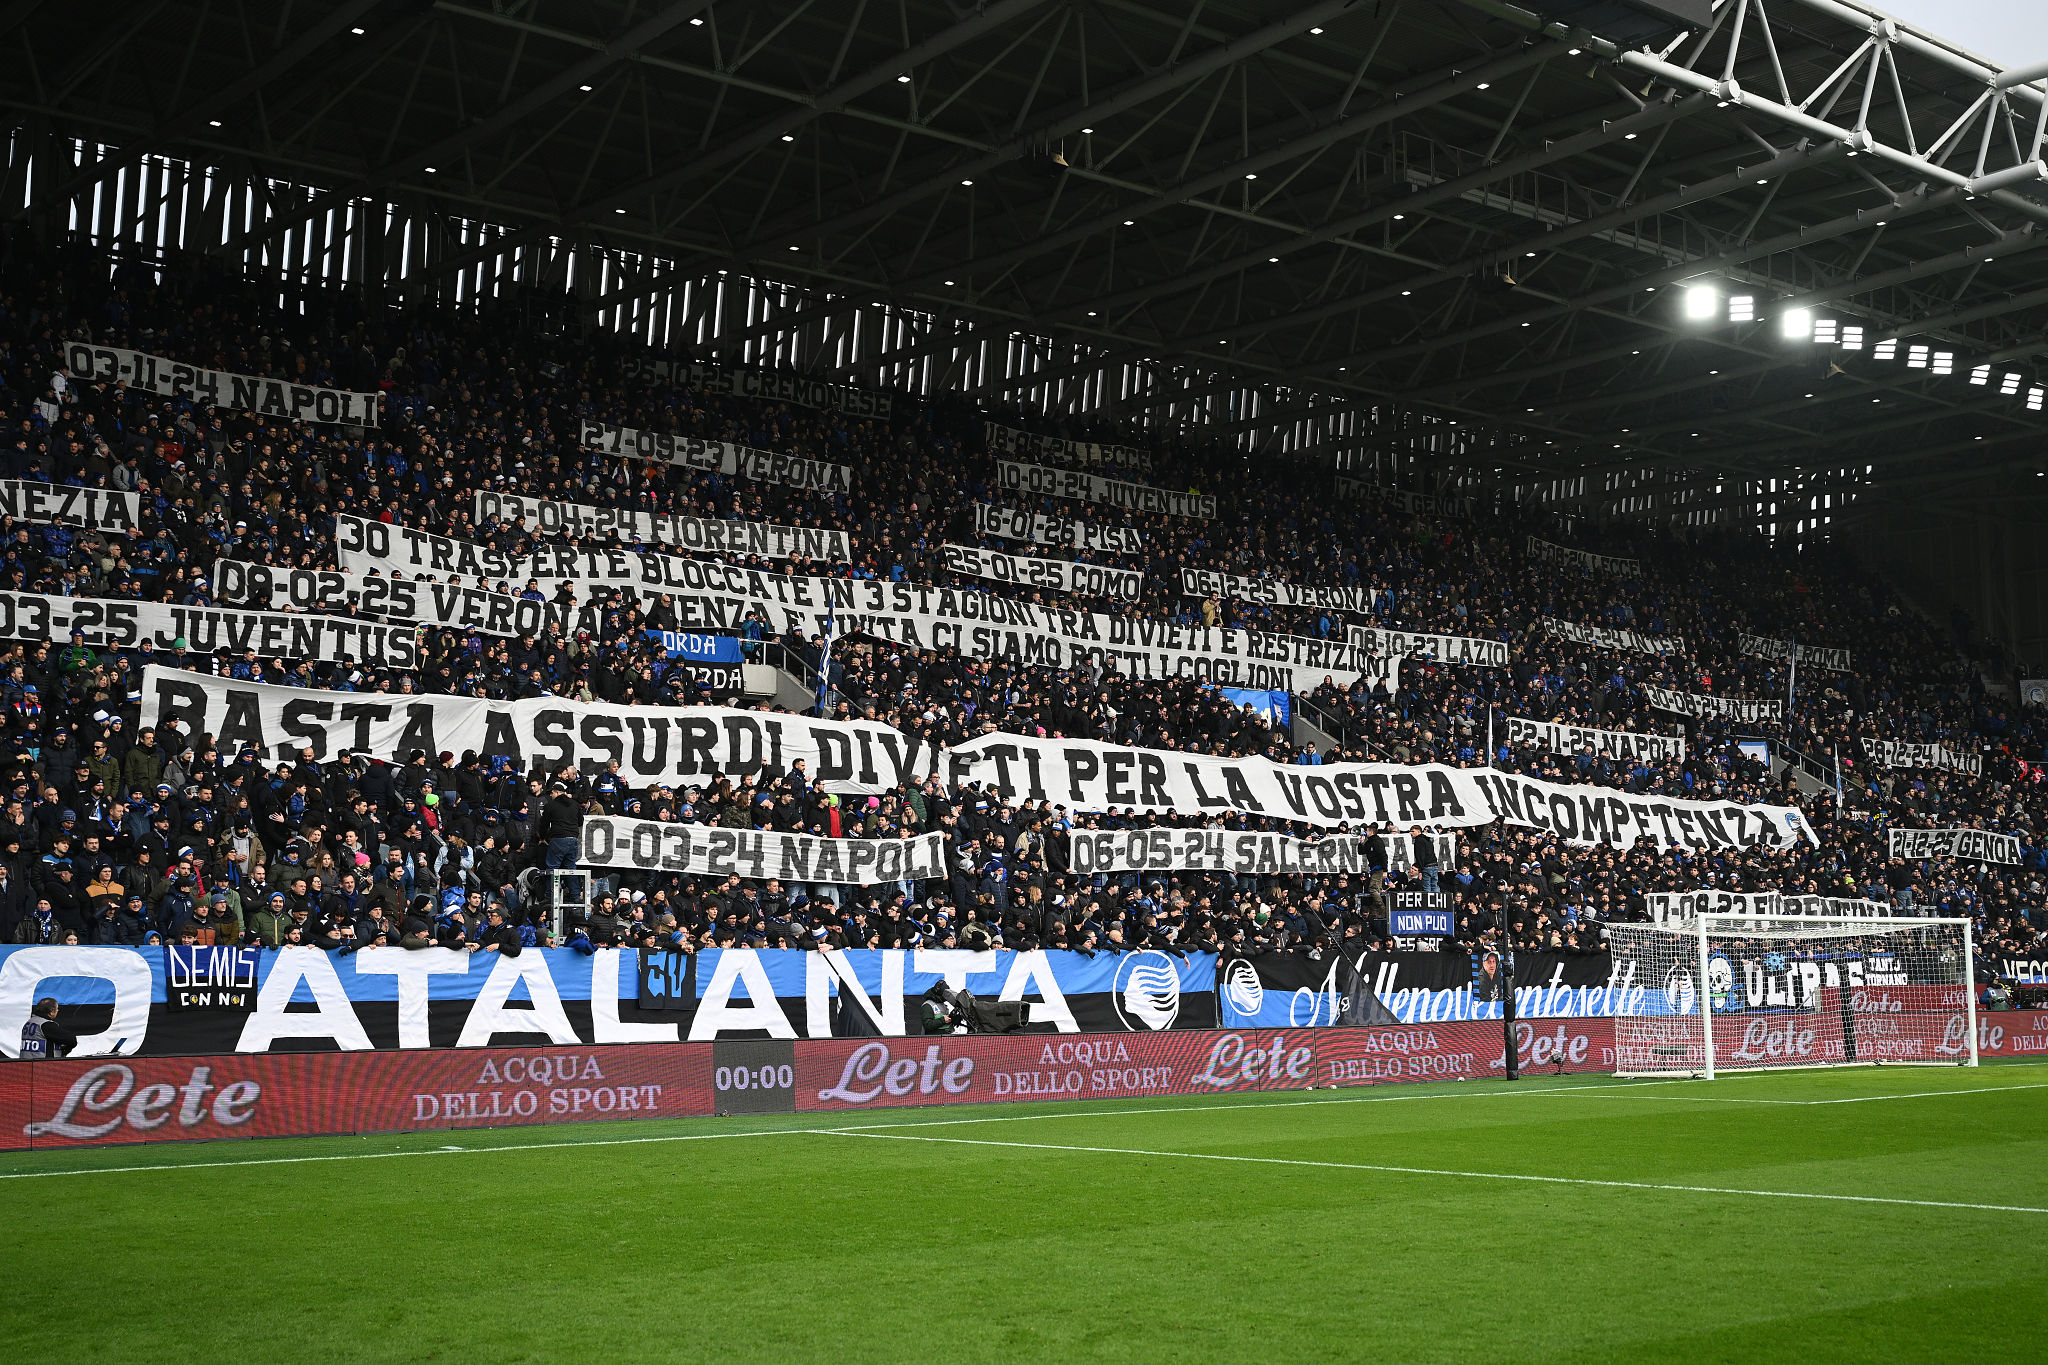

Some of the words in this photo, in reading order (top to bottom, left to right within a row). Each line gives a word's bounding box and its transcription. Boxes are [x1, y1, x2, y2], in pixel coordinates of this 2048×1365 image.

[68, 344, 219, 401] 03-11-24
[230, 376, 376, 428] NAPOLI
[743, 371, 891, 417] CREMONESE
[584, 423, 723, 469] 27-09-23
[736, 446, 848, 490] VERONA
[1000, 463, 1092, 500] 10-03-24
[1100, 481, 1214, 518] JUVENTUS
[481, 491, 638, 540] 03-04-24
[650, 514, 847, 561] FIORENTINA
[978, 504, 1076, 545] 16-01-26
[1084, 522, 1141, 552] PISA
[340, 515, 389, 559] 30
[403, 528, 631, 579] TRASFERTE
[640, 553, 813, 607] BLOCCATE
[820, 578, 855, 609] IN
[864, 581, 885, 611] 3
[892, 583, 1037, 627] STAGIONI
[1038, 605, 1100, 641] TRA
[1109, 614, 1211, 652] DIVIETI
[1220, 627, 1238, 655] E
[1246, 631, 1391, 678] RESTRIZIONI
[947, 548, 1063, 590] 25-01-25
[1071, 565, 1140, 601] COMO
[1183, 568, 1277, 604] 06-12-25
[1283, 583, 1375, 614] VERONA
[431, 583, 600, 644] VERONA
[155, 608, 415, 668] JUVENTUS
[663, 631, 716, 655] ORDA
[932, 622, 962, 655] CI
[972, 627, 1062, 668] SIAMO
[1178, 656, 1293, 690] COGLIONI
[1446, 639, 1506, 667] LAZIO
[687, 665, 742, 690] RDA
[156, 677, 438, 767] BASTA
[479, 709, 786, 778] ASSURDI
[1064, 748, 1174, 806] PER
[1184, 762, 1264, 812] LA
[1273, 769, 1464, 822] VOSTRA
[1473, 774, 1783, 847] INCOMPETENZA
[1601, 733, 1681, 763] NAPOLI
[780, 835, 944, 883] NAPOLI
[1073, 830, 1225, 874] 06-05-24
[1235, 835, 1455, 873] SALERNAA
[1958, 831, 2023, 864] GENOA
[1396, 892, 1422, 908] PER
[1427, 892, 1447, 909] CHI
[1397, 915, 1423, 931] NON
[168, 944, 256, 988] DEMIS
[235, 944, 1081, 1053] ATALANTA
[1365, 1030, 1440, 1054] ACQUA
[1489, 1022, 1590, 1071] Lete
[1731, 1017, 1815, 1060] Lete
[1825, 1039, 1873, 1056] DELO
[1855, 1018, 1899, 1036] CQUA
[476, 1054, 605, 1087] ACQUA
[818, 1041, 975, 1103] Lete
[1038, 1040, 1130, 1068] ACQUA
[1192, 1033, 1312, 1087] Lete
[1330, 1058, 1402, 1080] DELLO
[1409, 1052, 1475, 1077] SPORT
[714, 1064, 794, 1092] 00:00
[994, 1071, 1083, 1096] DELLO
[1091, 1066, 1173, 1093] SPORT
[23, 1063, 262, 1140] Lete
[413, 1088, 538, 1121] DELLO
[549, 1085, 662, 1116] SPORT
